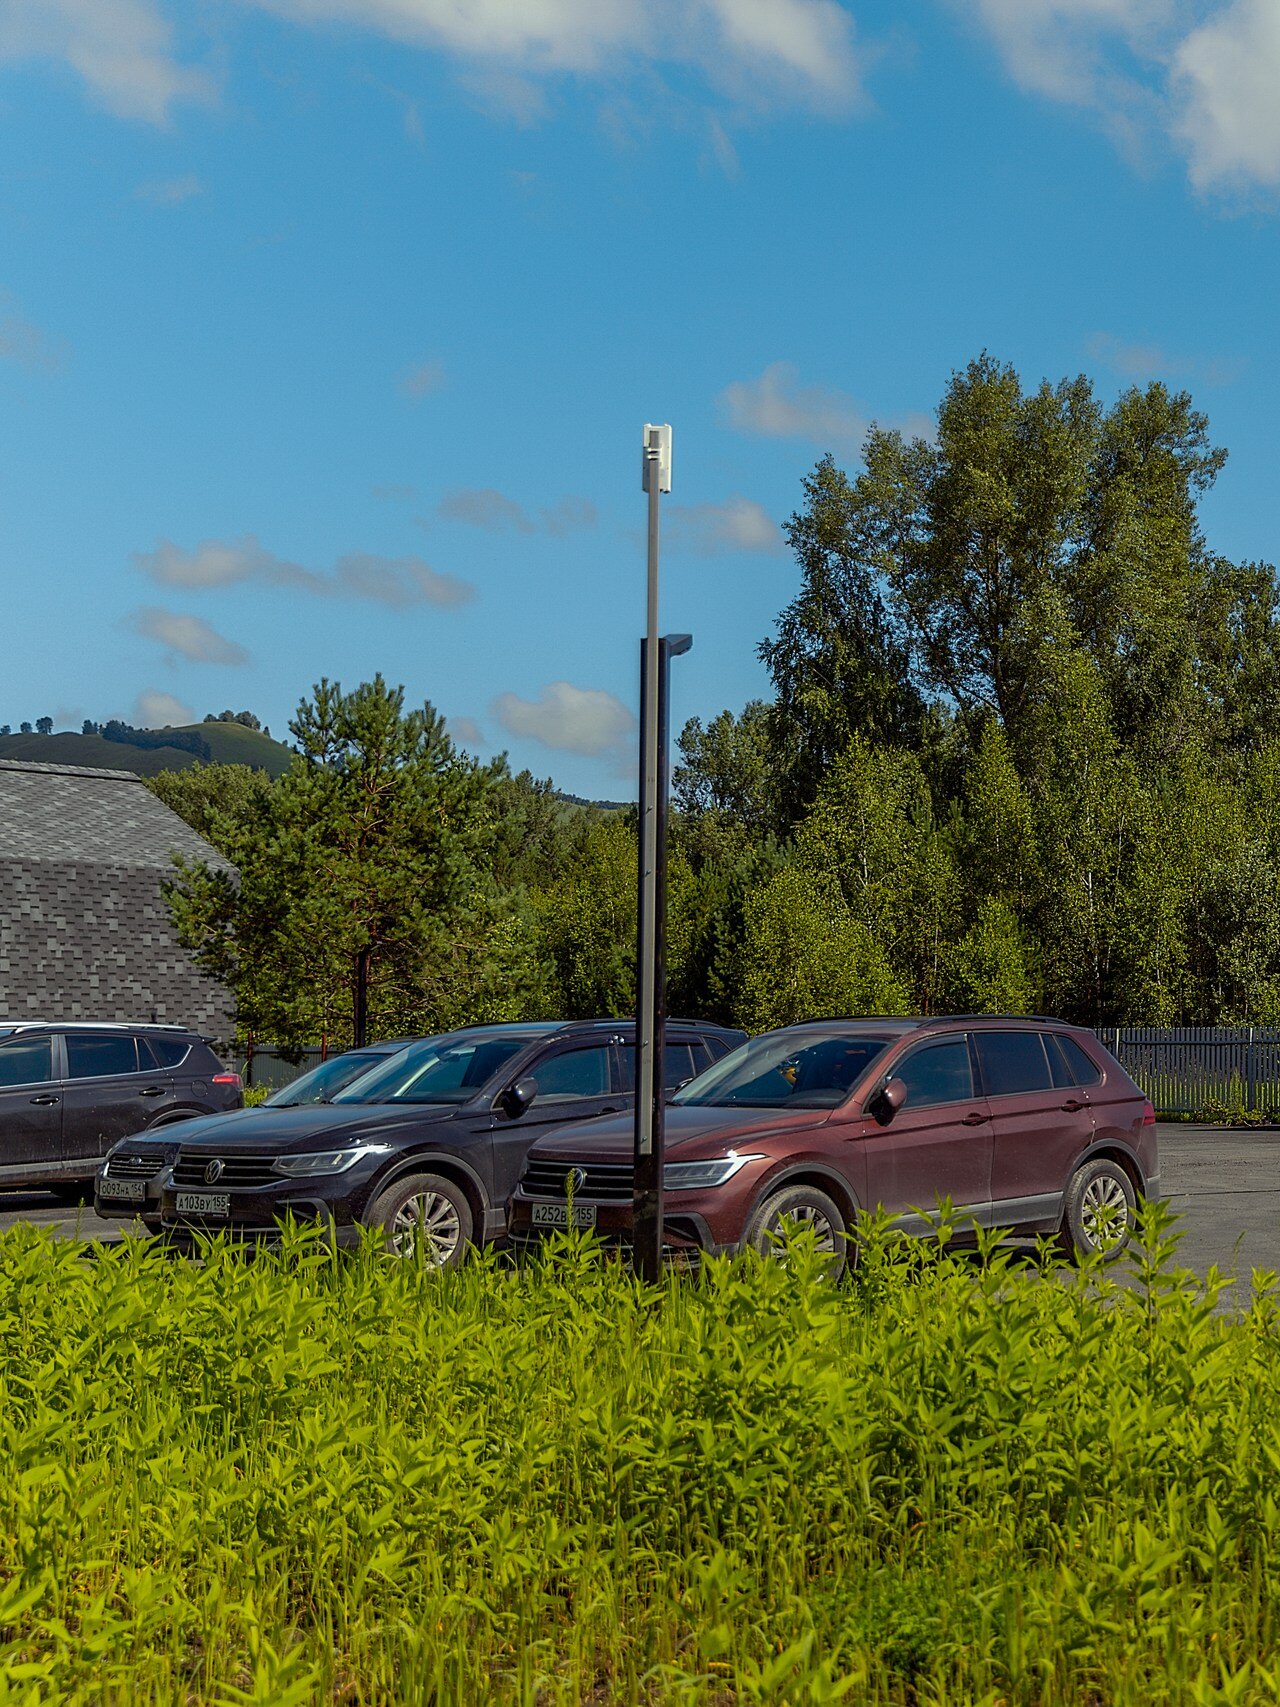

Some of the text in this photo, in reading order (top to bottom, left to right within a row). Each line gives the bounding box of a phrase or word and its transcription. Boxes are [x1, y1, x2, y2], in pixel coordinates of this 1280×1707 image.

[212, 1196, 226, 1207] 155
[534, 1206, 593, 1223] А252В 155
